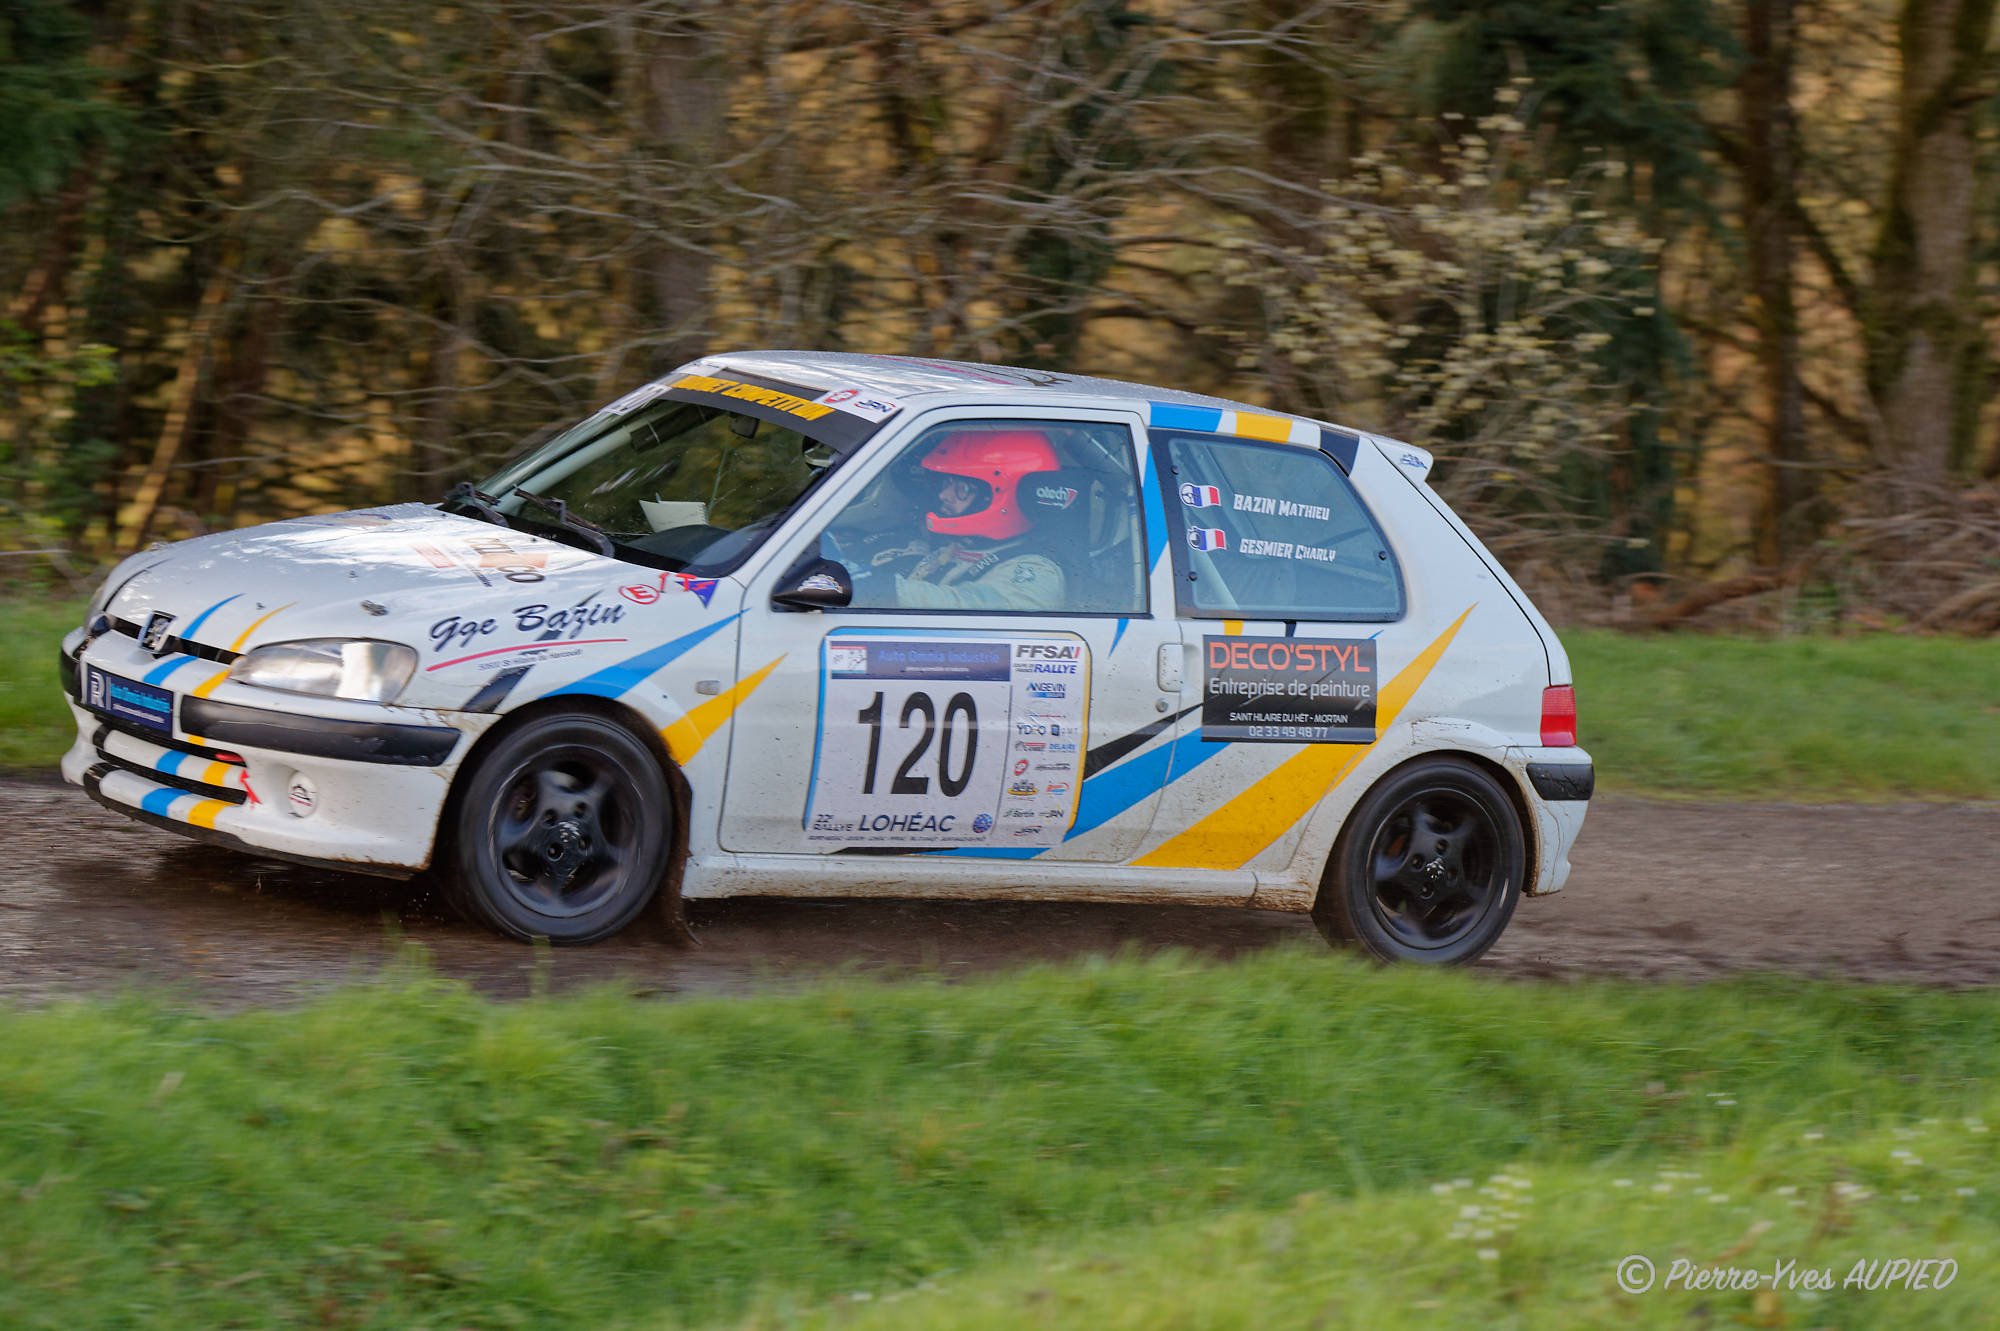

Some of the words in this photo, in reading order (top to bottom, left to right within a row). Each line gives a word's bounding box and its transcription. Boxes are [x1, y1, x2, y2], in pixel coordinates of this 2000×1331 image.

[1233, 493, 1276, 516] BAZIN
[1278, 500, 1330, 521] MATHIEU
[1239, 538, 1293, 559] GESMIER
[1294, 544, 1337, 562] CHARLY
[513, 602, 625, 639] Bazin
[1016, 645, 1073, 659] FFSA
[1209, 641, 1371, 673] DECO'STYL
[1034, 664, 1078, 674] RALLYE
[1209, 677, 1285, 699] Entreprise
[1288, 679, 1307, 696] de
[1310, 680, 1371, 700] peinture
[1229, 712, 1253, 721] SAINT
[1283, 713, 1294, 722] DU
[1314, 714, 1349, 723] MORTAIN
[1248, 725, 1263, 737] 02
[1265, 726, 1279, 737] 33
[1282, 726, 1296, 737] 49
[1314, 727, 1328, 738] 77
[857, 691, 978, 797] 120
[858, 812, 956, 832] LOHÉAC
